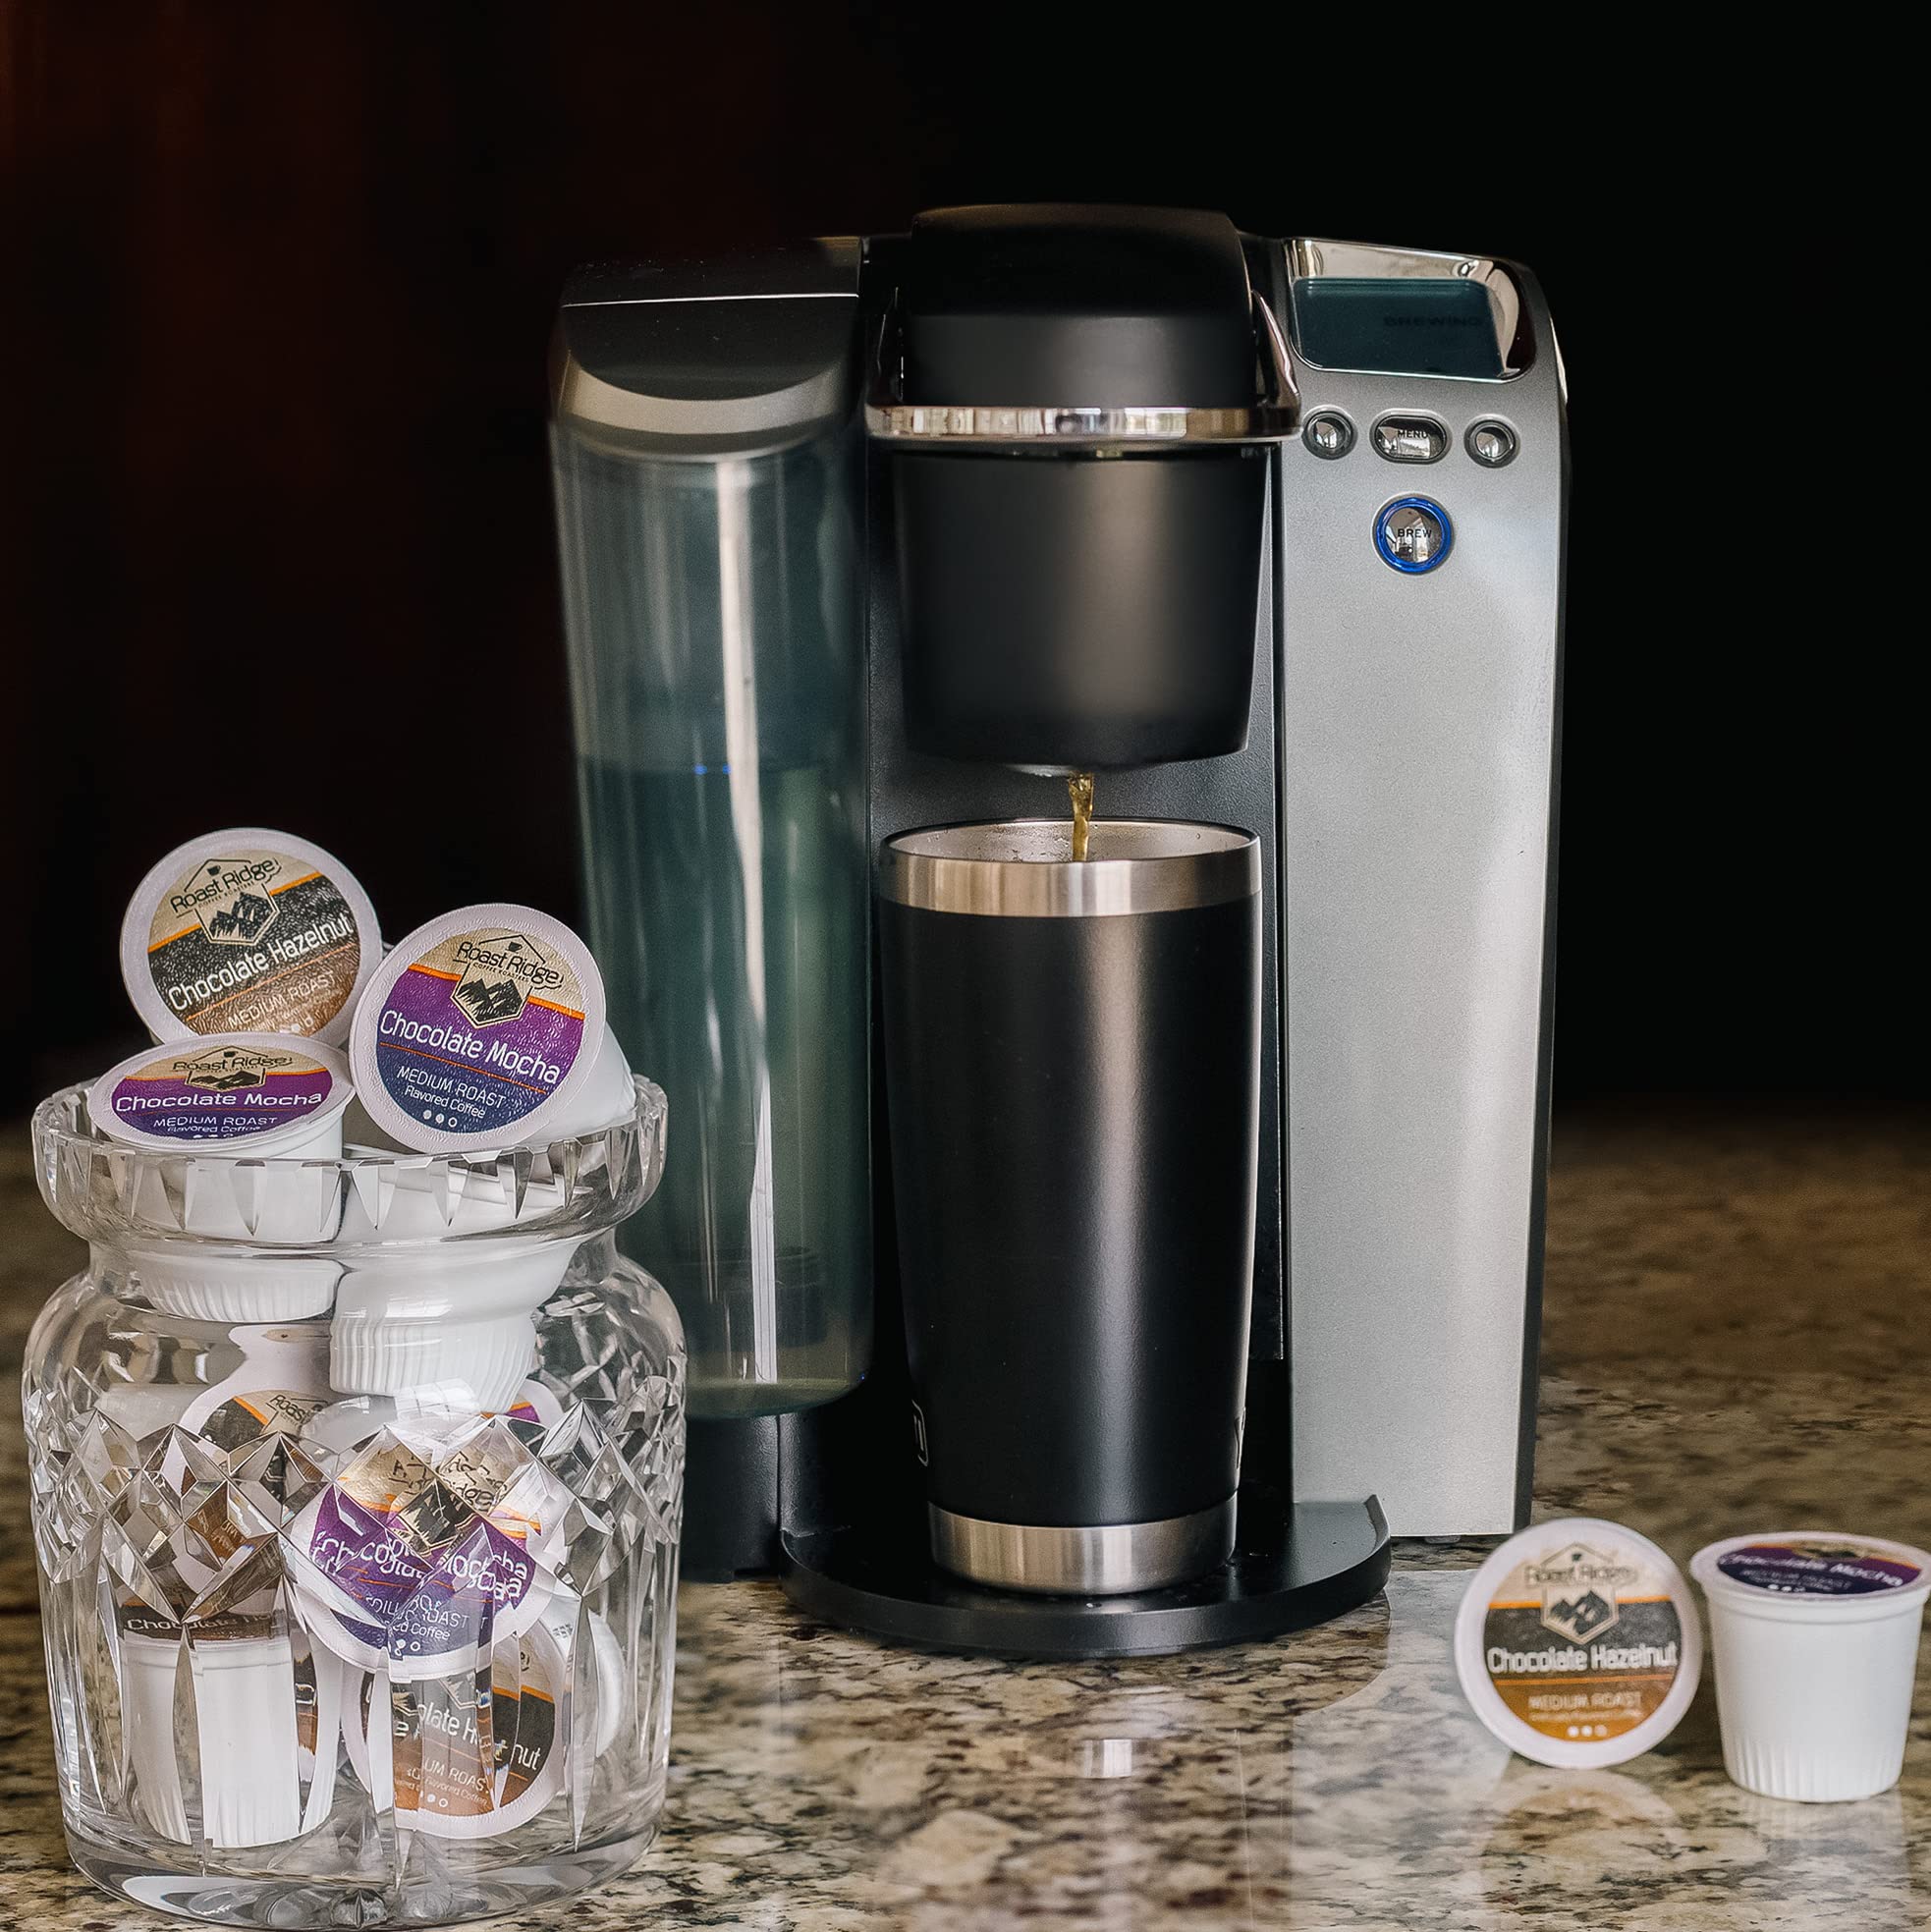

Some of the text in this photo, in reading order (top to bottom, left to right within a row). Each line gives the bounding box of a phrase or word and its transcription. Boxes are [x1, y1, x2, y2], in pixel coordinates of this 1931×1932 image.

[1397, 428, 1429, 439] MENU
[1397, 527, 1433, 539] BREW
[170, 859, 276, 913] Roast Ridge
[168, 951, 269, 1012] Chocolate
[267, 914, 355, 965] Hazelnut
[457, 941, 560, 984] Roast Ridge
[228, 994, 287, 1028] MEDIUM
[288, 974, 336, 1000] ROAST
[173, 1059, 228, 1071] Roast
[231, 1056, 288, 1069] Ridge
[380, 1010, 560, 1084] Chocolate Mocha
[116, 1092, 323, 1113] Chocolate Mocha
[397, 1066, 507, 1108] MEDIUM ROAST
[404, 1085, 486, 1119] Flavored Coffee
[153, 1116, 278, 1128] MEDIUM ROAST
[411, 1622, 451, 1640] Coffee
[1487, 1641, 1679, 1674] Chocolate Hazelnut
